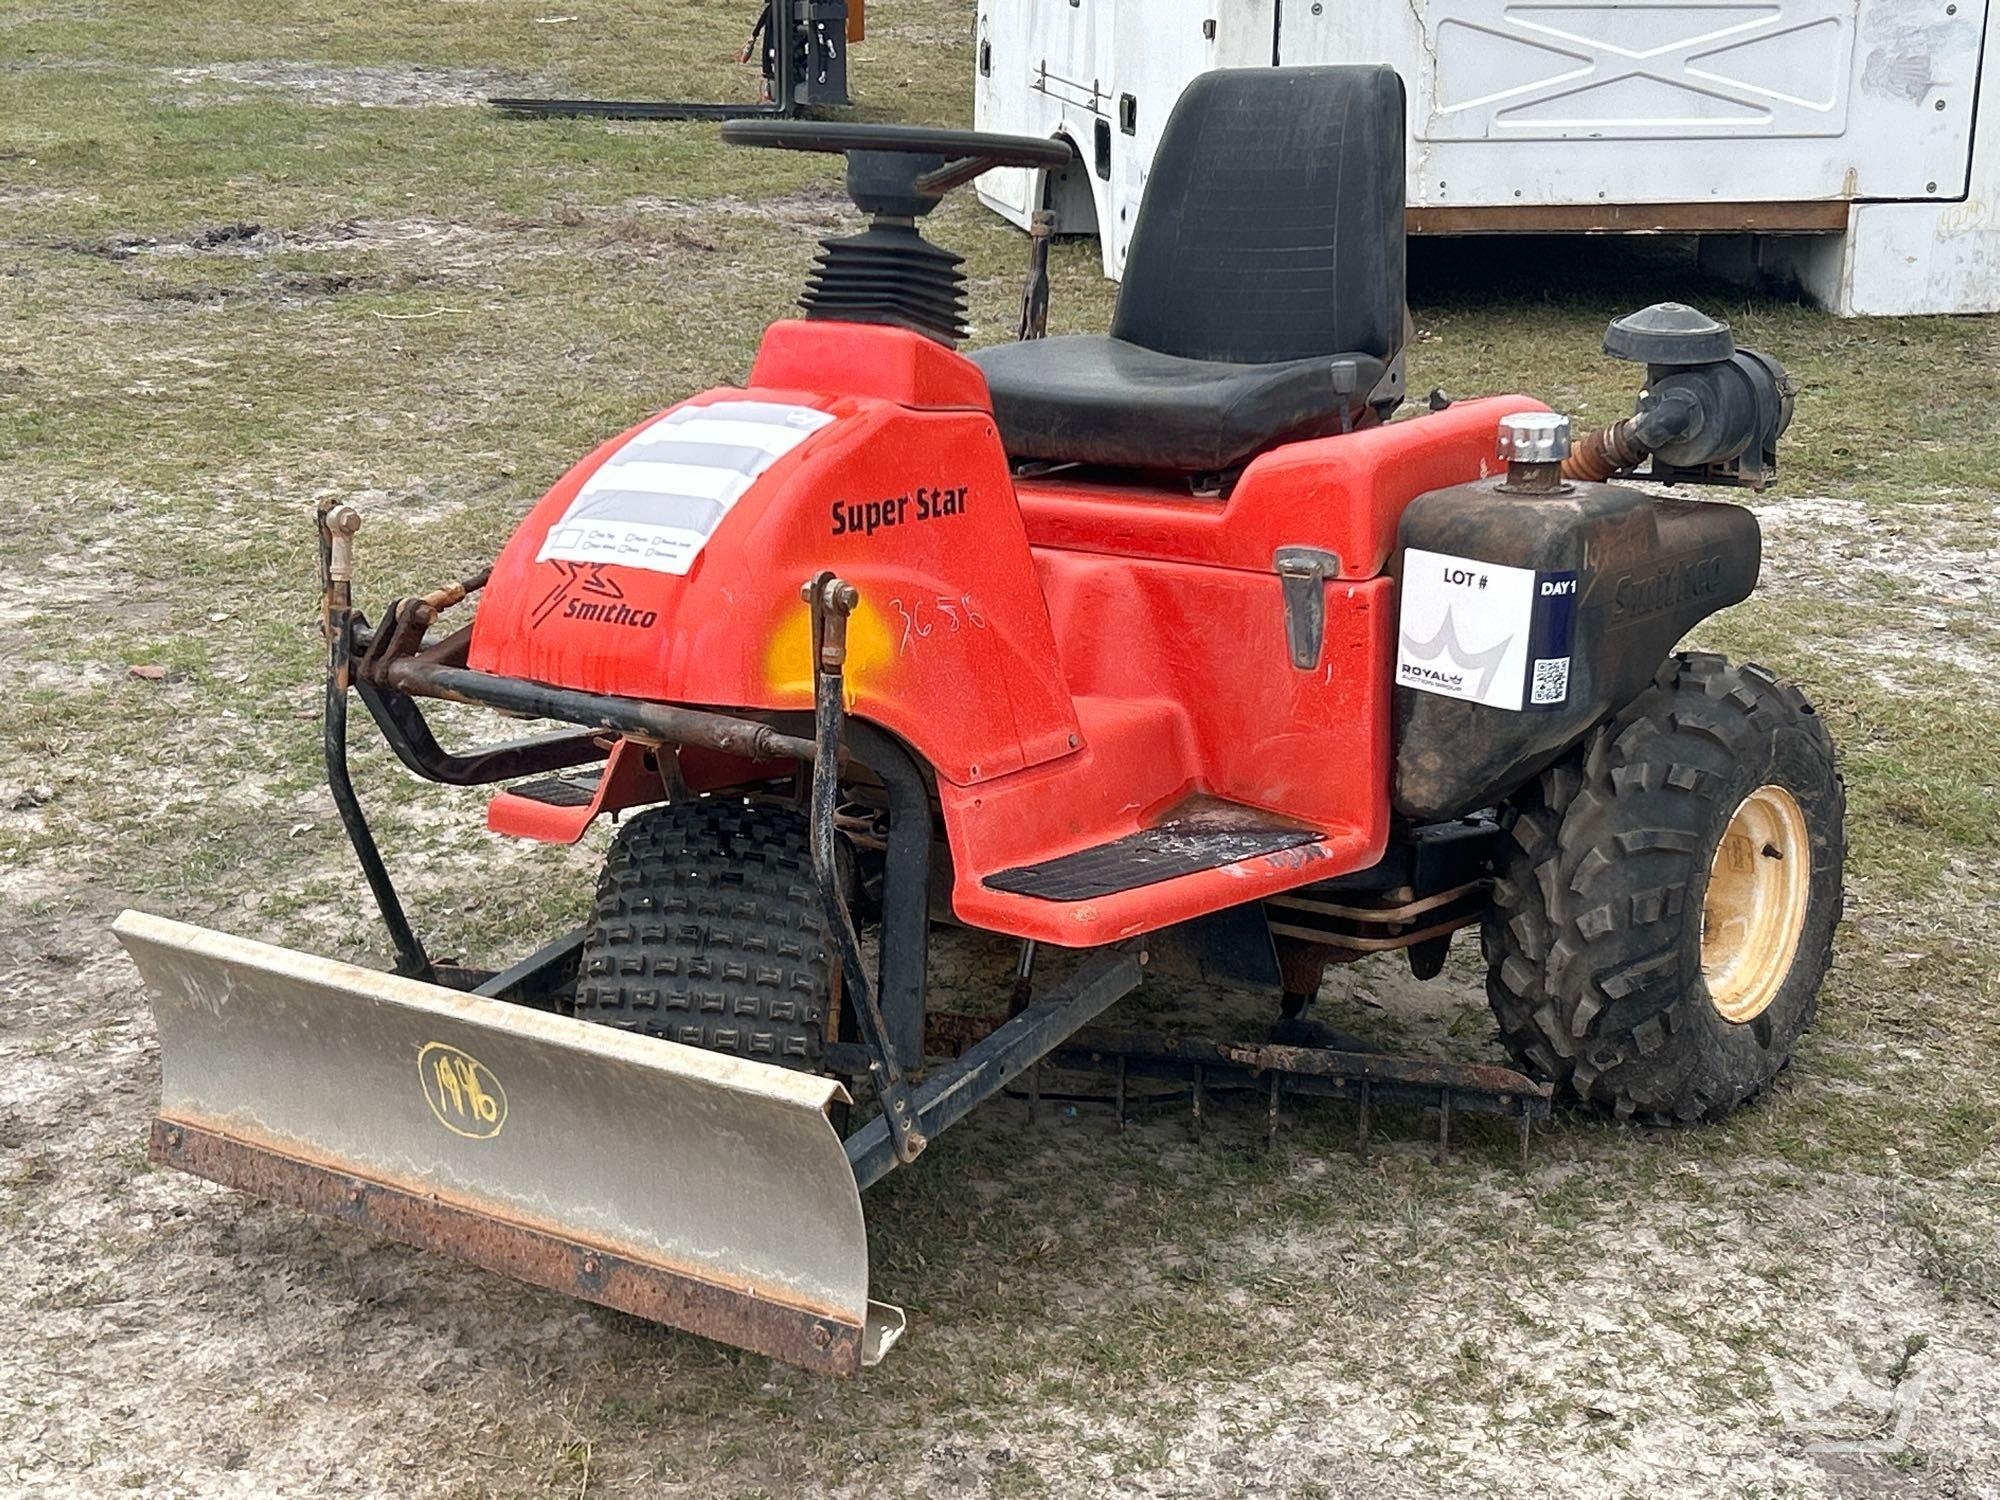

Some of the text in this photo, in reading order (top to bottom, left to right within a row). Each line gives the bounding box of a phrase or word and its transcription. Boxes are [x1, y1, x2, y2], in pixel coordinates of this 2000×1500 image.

[832, 486, 968, 536] Super Star
[1443, 568, 1489, 590] LOT #
[1540, 580, 1577, 596] DAY 1
[563, 597, 657, 629] Smithco
[1401, 664, 1449, 683] ROYAL
